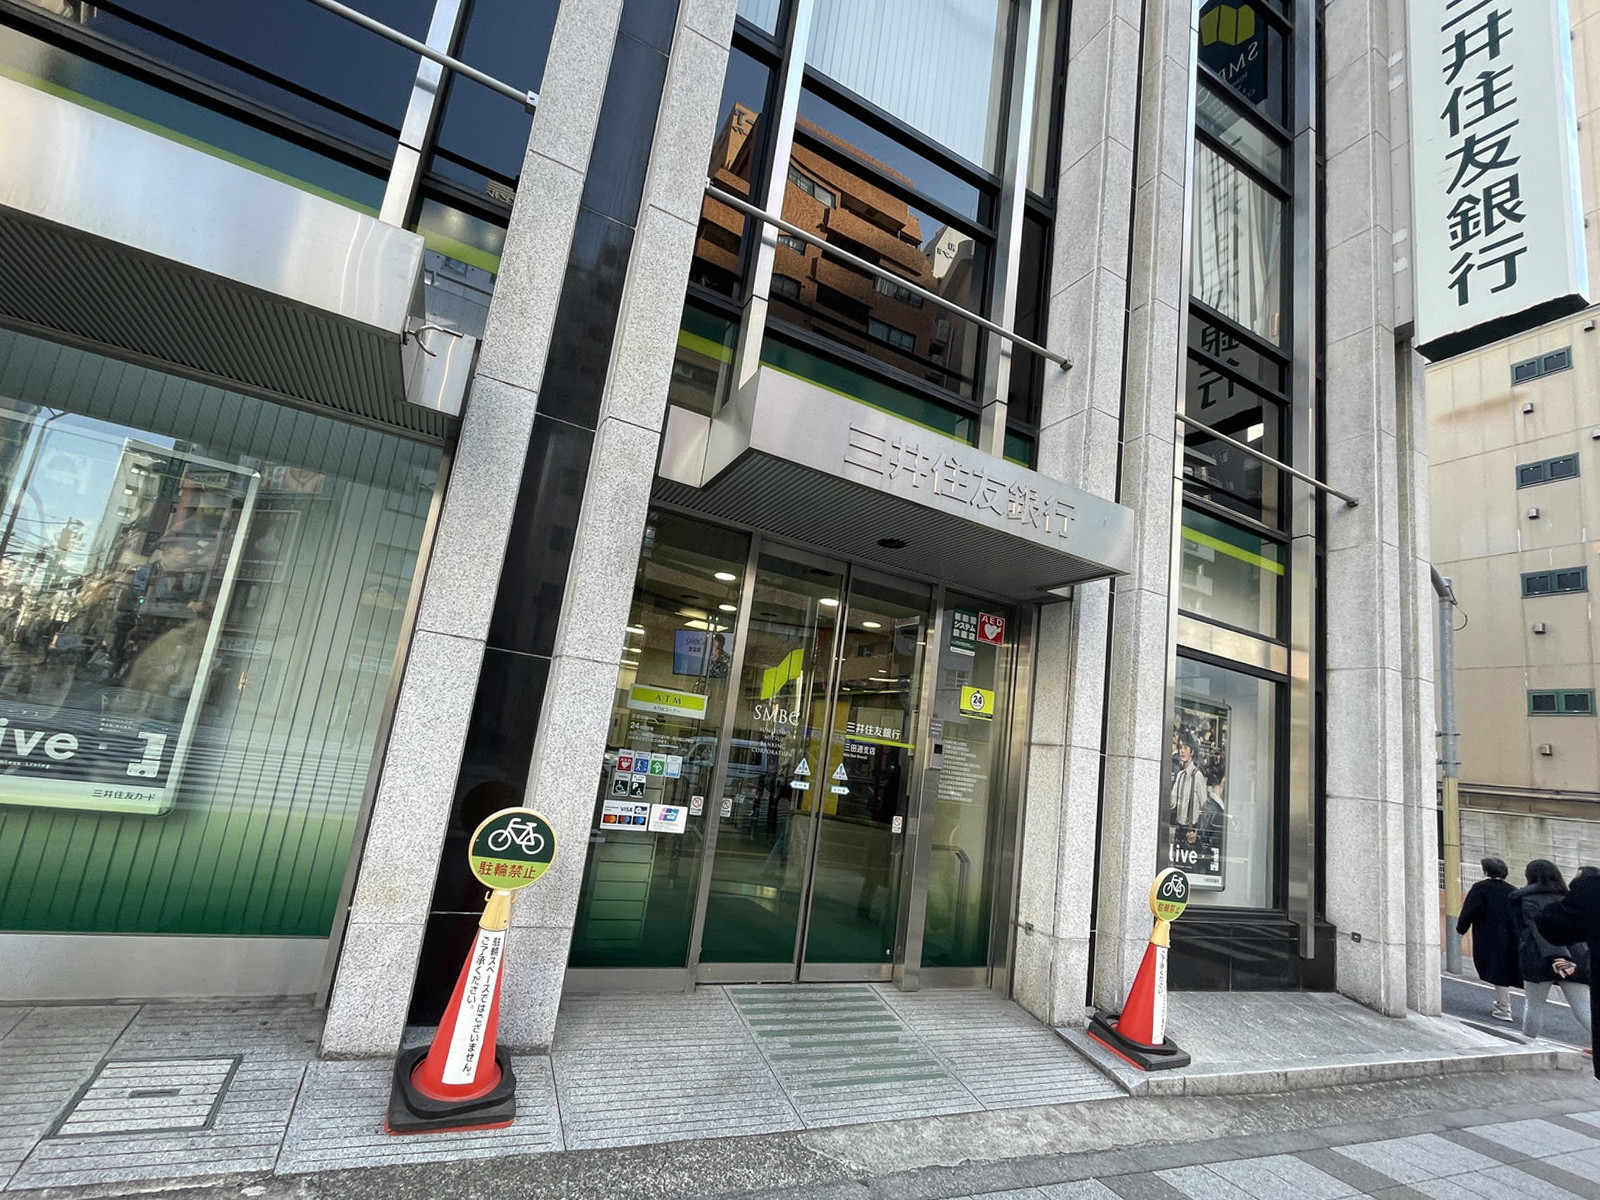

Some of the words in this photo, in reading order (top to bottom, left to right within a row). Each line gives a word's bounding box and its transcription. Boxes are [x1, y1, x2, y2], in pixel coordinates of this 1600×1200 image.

[844, 422, 1076, 538] 三井住友銀行
[954, 621, 976, 632] システム
[981, 615, 1003, 627] AED
[655, 694, 682, 705] ATM
[973, 695, 983, 705] 24
[753, 704, 800, 726] SMBC
[846, 721, 901, 740] 三井住友銀行
[92, 788, 156, 801] 三井住友カード
[1169, 843, 1198, 864] live
[478, 861, 537, 879] 駐輪禁止
[467, 936, 490, 1009] ご了承ください。
